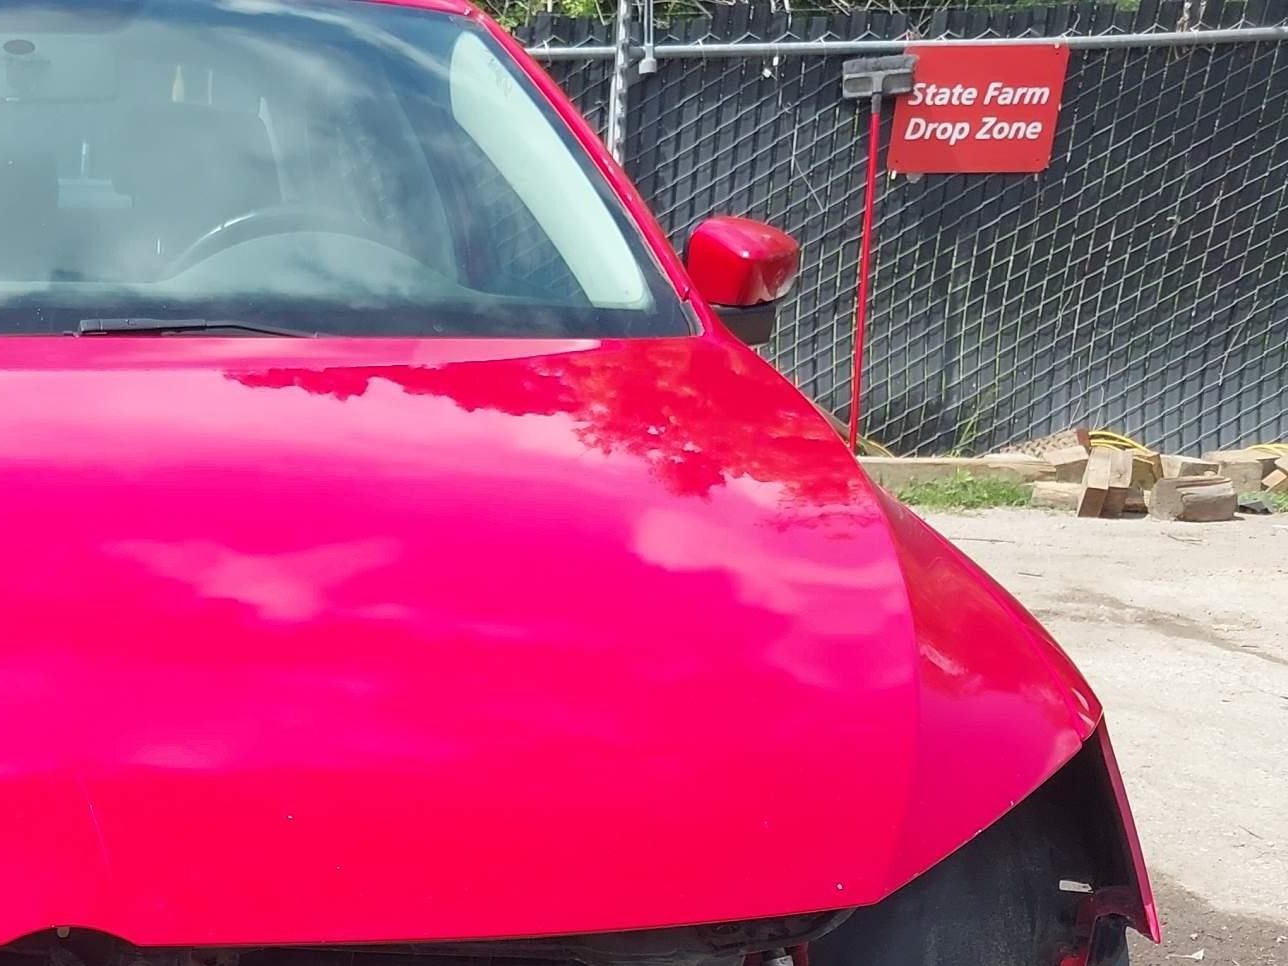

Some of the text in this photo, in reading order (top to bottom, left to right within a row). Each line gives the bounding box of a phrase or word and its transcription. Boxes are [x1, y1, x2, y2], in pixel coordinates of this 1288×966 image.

[908, 82, 1049, 106] State Farm
[904, 117, 1042, 145] Drop Zone
